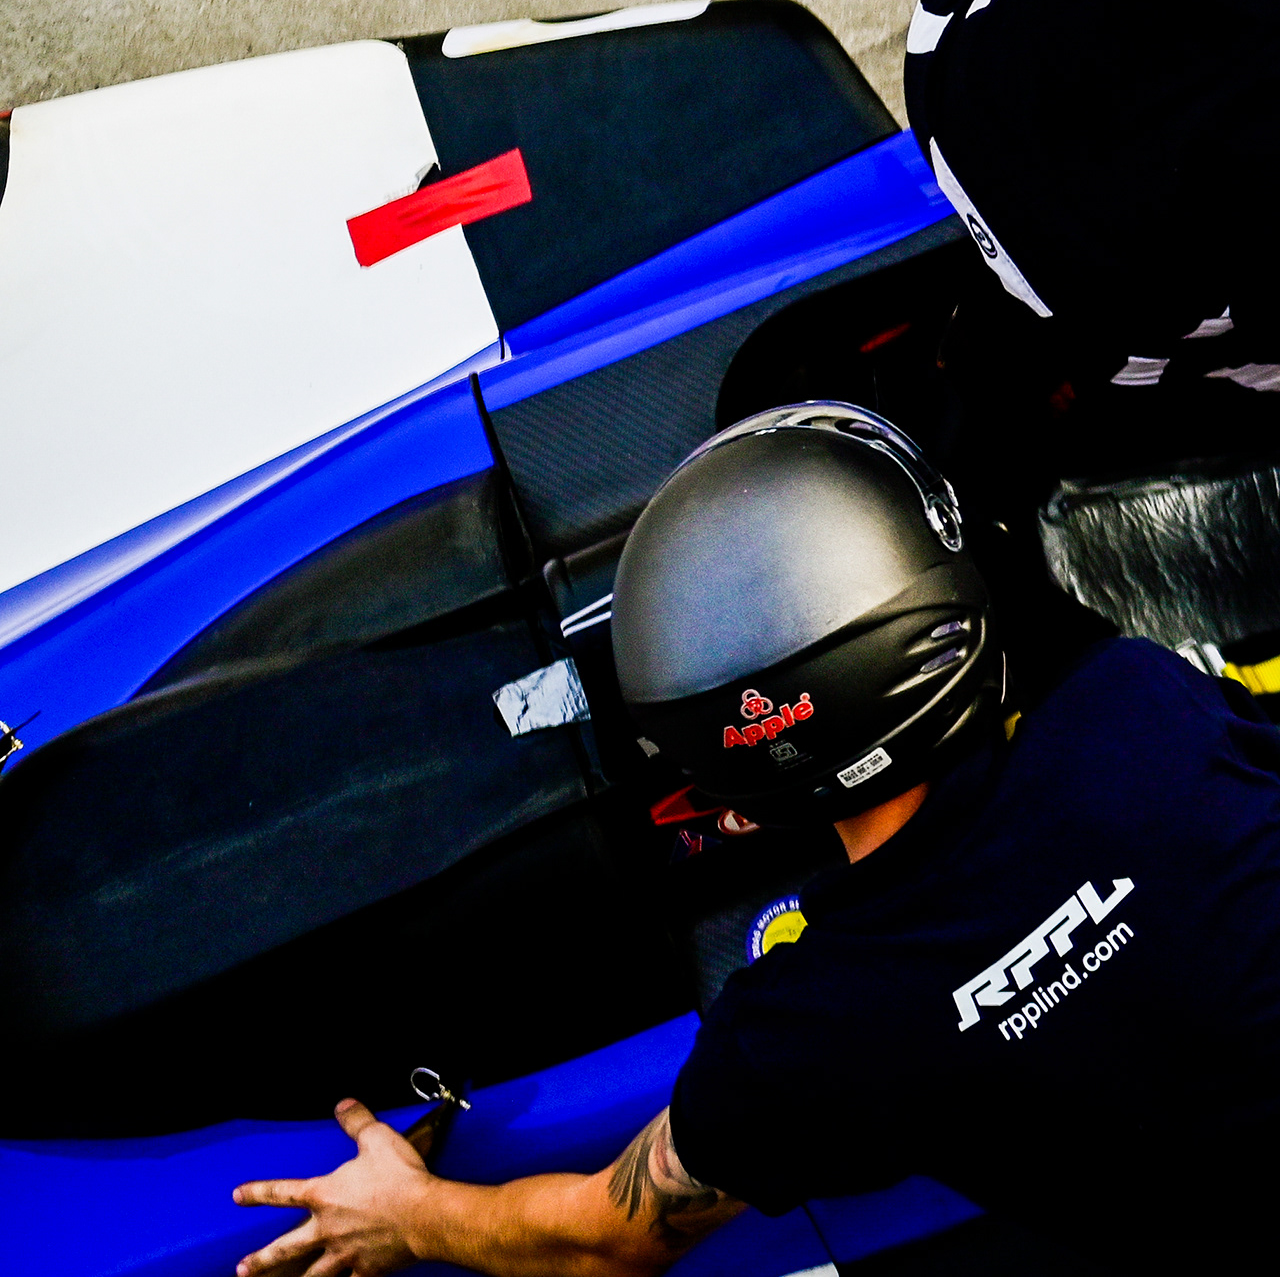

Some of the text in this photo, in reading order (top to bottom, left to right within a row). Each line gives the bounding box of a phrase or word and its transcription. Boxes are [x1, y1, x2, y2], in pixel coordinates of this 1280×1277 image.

[723, 701, 815, 749] Apple
[952, 877, 1135, 1032] RPPL
[998, 921, 1135, 1041] rpplind.com
